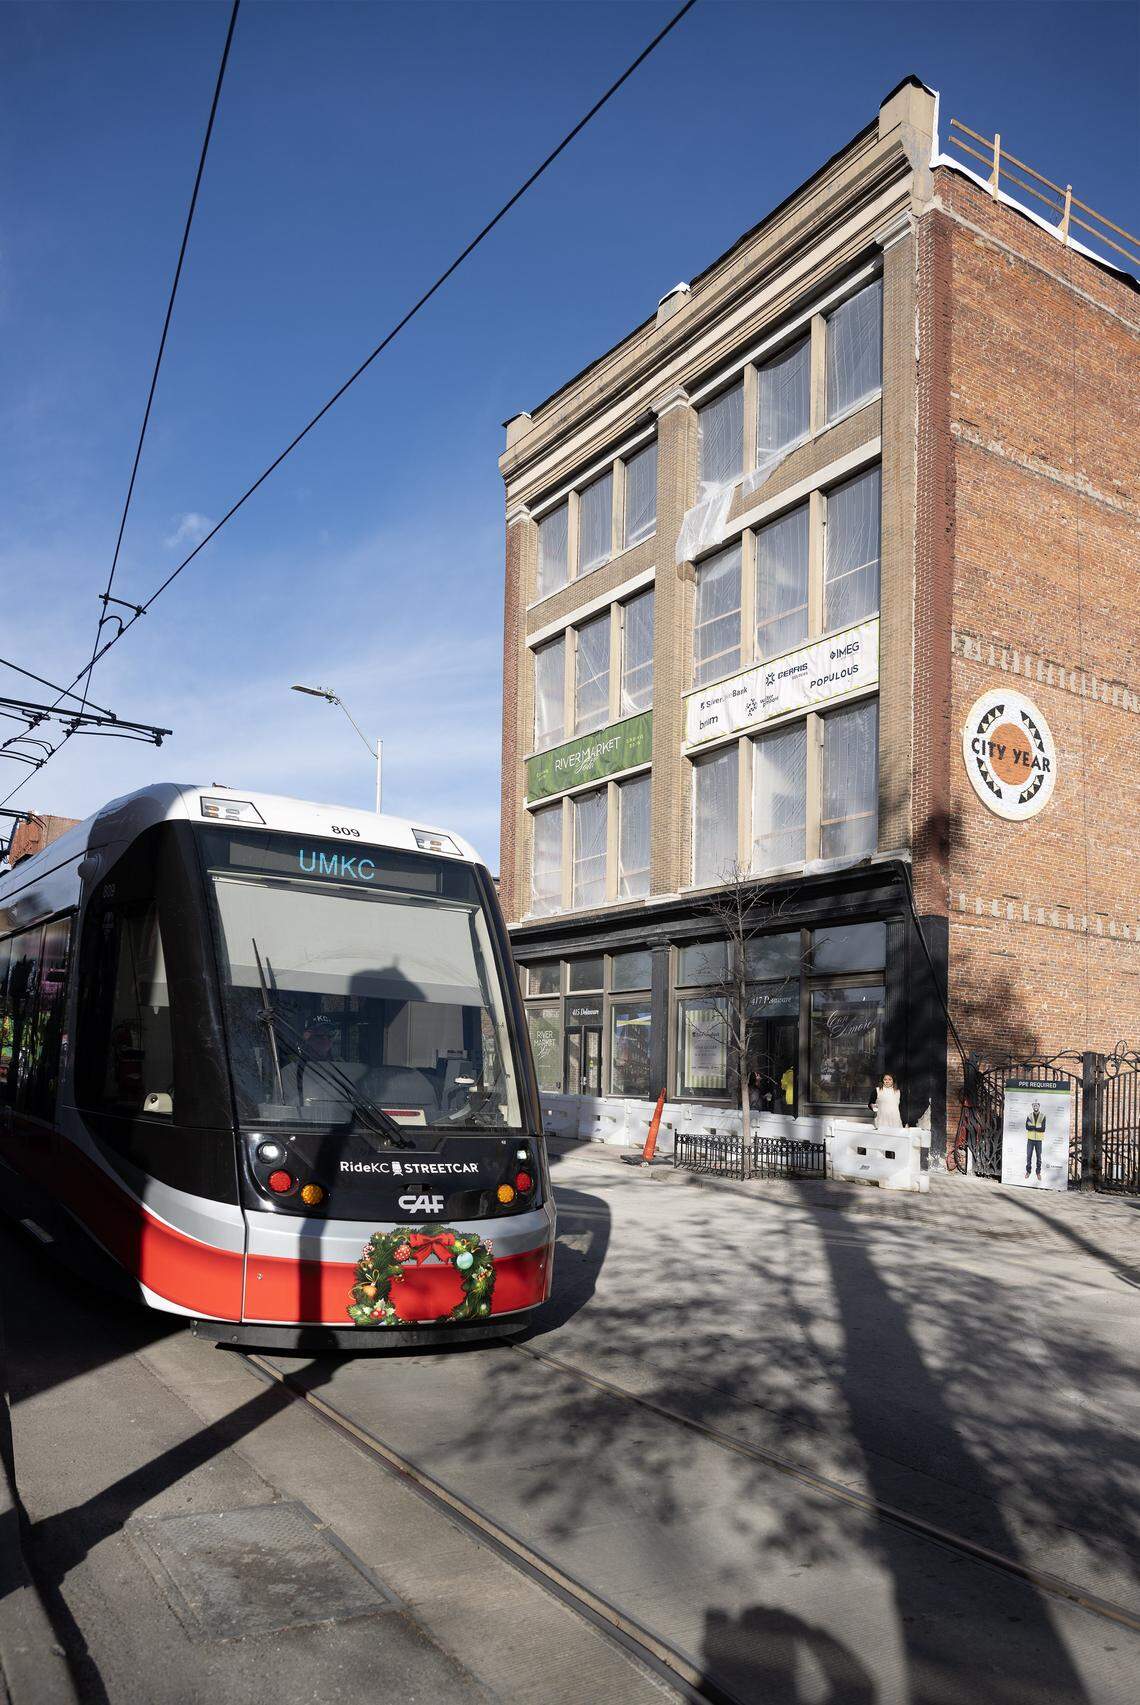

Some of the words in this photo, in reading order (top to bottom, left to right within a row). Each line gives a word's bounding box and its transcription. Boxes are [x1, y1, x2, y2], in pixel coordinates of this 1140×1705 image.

[836, 641, 860, 659] IMEG
[810, 664, 859, 688] POPULOUS
[971, 737, 1006, 761] CITY
[1013, 748, 1051, 773] YEAR
[331, 825, 360, 837] 809
[299, 849, 376, 880] UMKC
[340, 1161, 390, 1174] RideKC
[404, 1163, 480, 1174] STREETCAR
[398, 1195, 445, 1214] CAF
